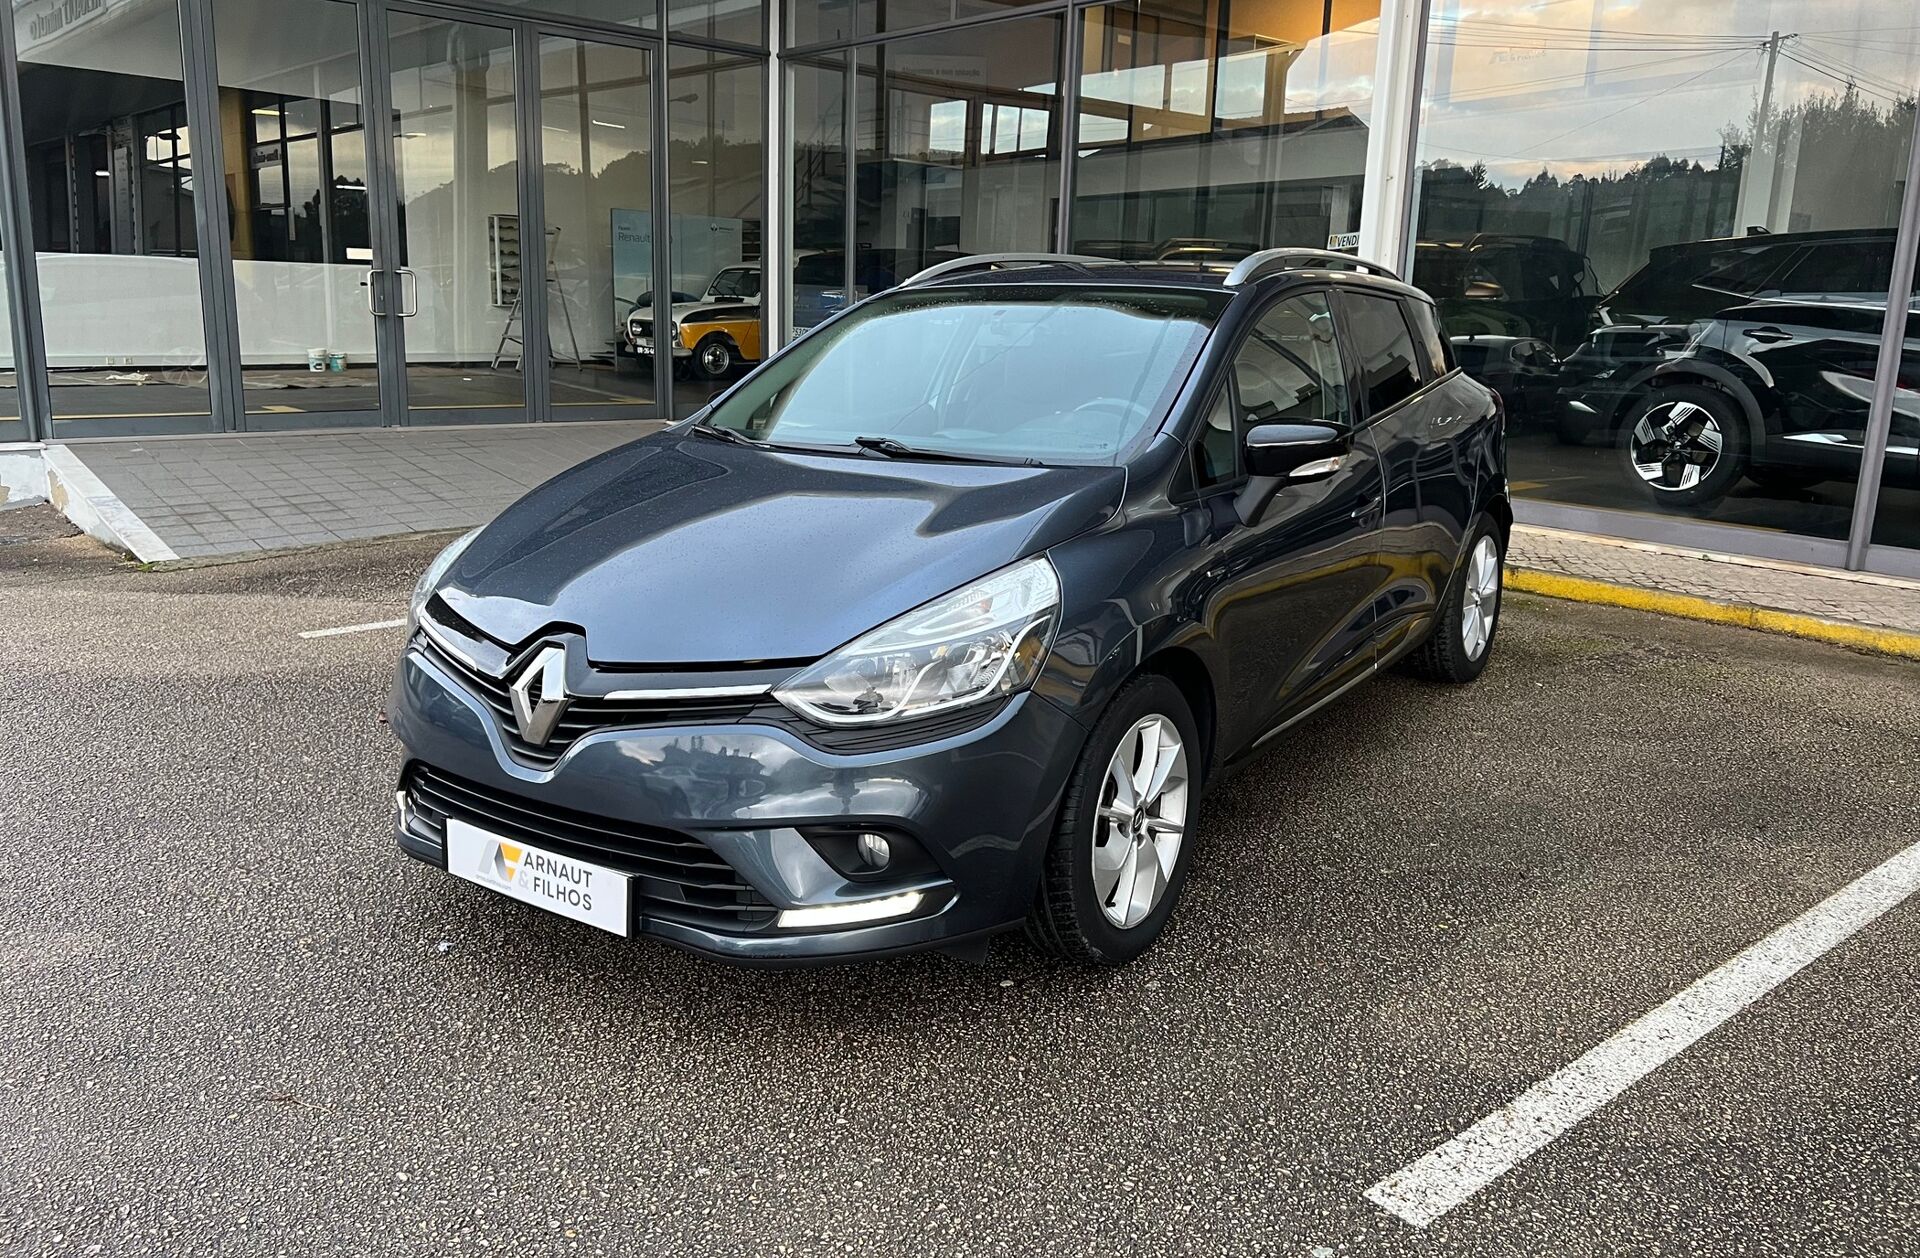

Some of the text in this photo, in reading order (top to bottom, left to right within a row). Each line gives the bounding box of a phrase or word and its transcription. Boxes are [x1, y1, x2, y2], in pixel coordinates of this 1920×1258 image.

[618, 231, 651, 243] Renault
[524, 852, 593, 888] ARNAUT
[518, 869, 530, 890] &
[533, 876, 593, 911] FILHOS
